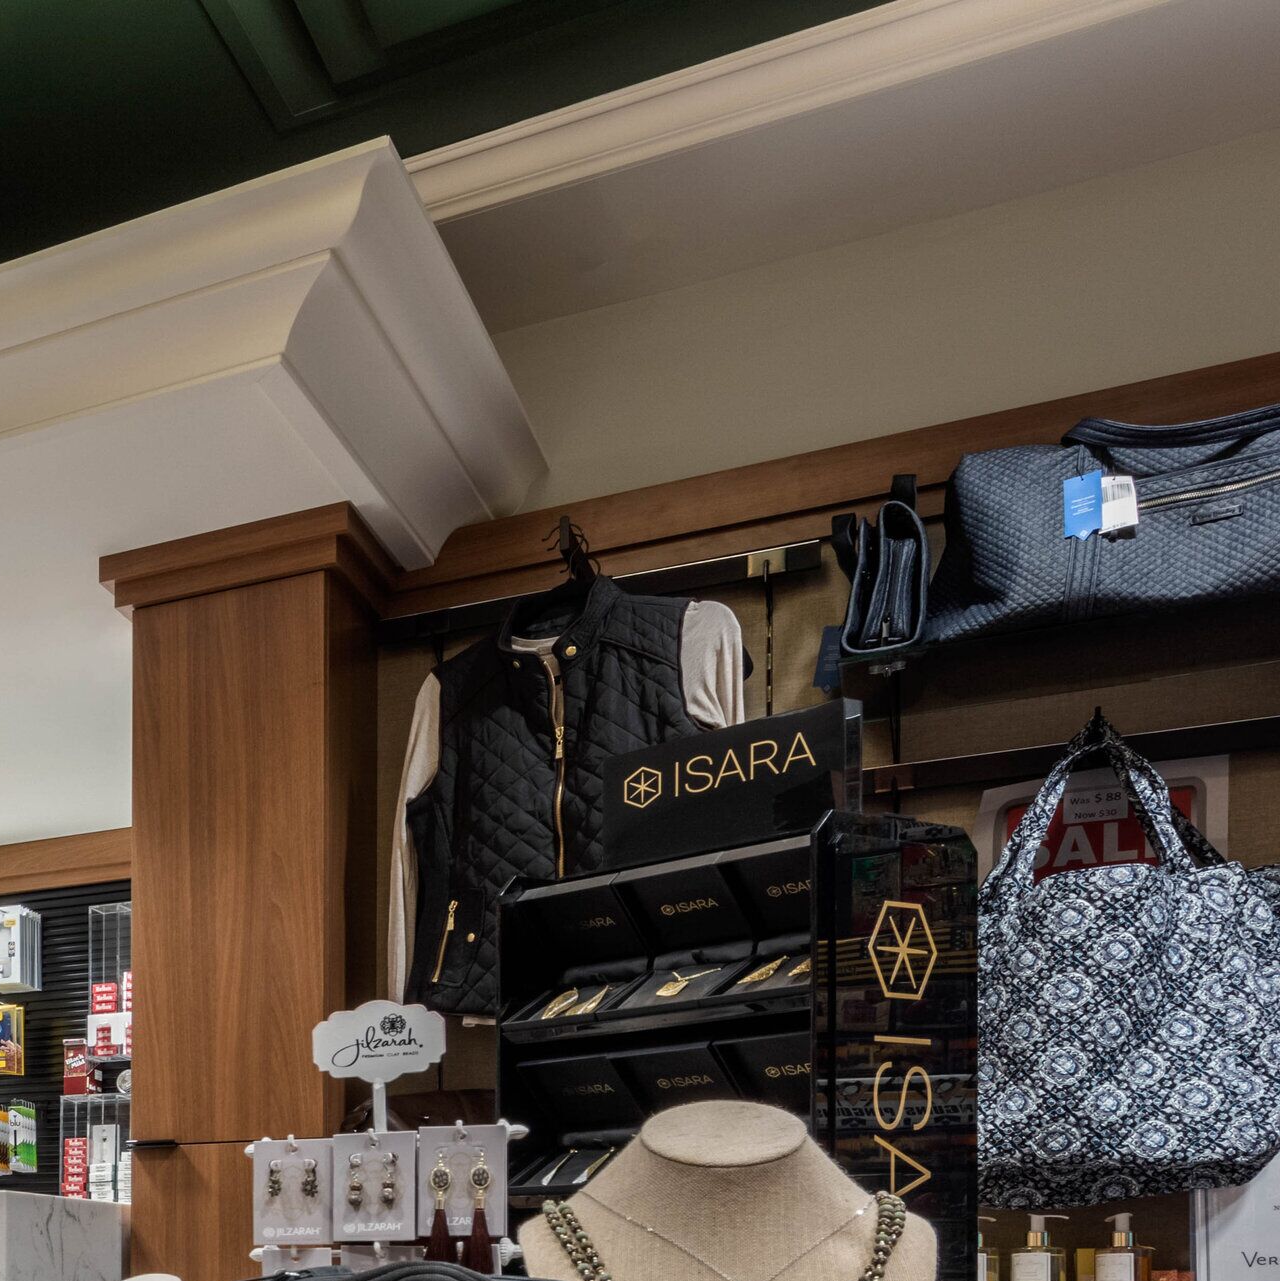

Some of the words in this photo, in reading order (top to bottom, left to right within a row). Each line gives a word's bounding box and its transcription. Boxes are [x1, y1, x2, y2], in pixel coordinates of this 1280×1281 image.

[674, 731, 817, 798] ISARA
[1070, 796, 1091, 806] Was
[1105, 791, 1123, 802] 88
[1074, 811, 1097, 820] Now
[1099, 808, 1117, 818] $30
[676, 898, 719, 914] ISARA
[578, 916, 616, 929] SARA
[671, 1074, 714, 1087] ISARA
[10, 1116, 21, 1128] blu
[873, 1034, 932, 1197] ISA
[276, 1226, 321, 1237] JILZARAH
[355, 1222, 403, 1233] JILZARAH
[1241, 1251, 1280, 1268] Ver
